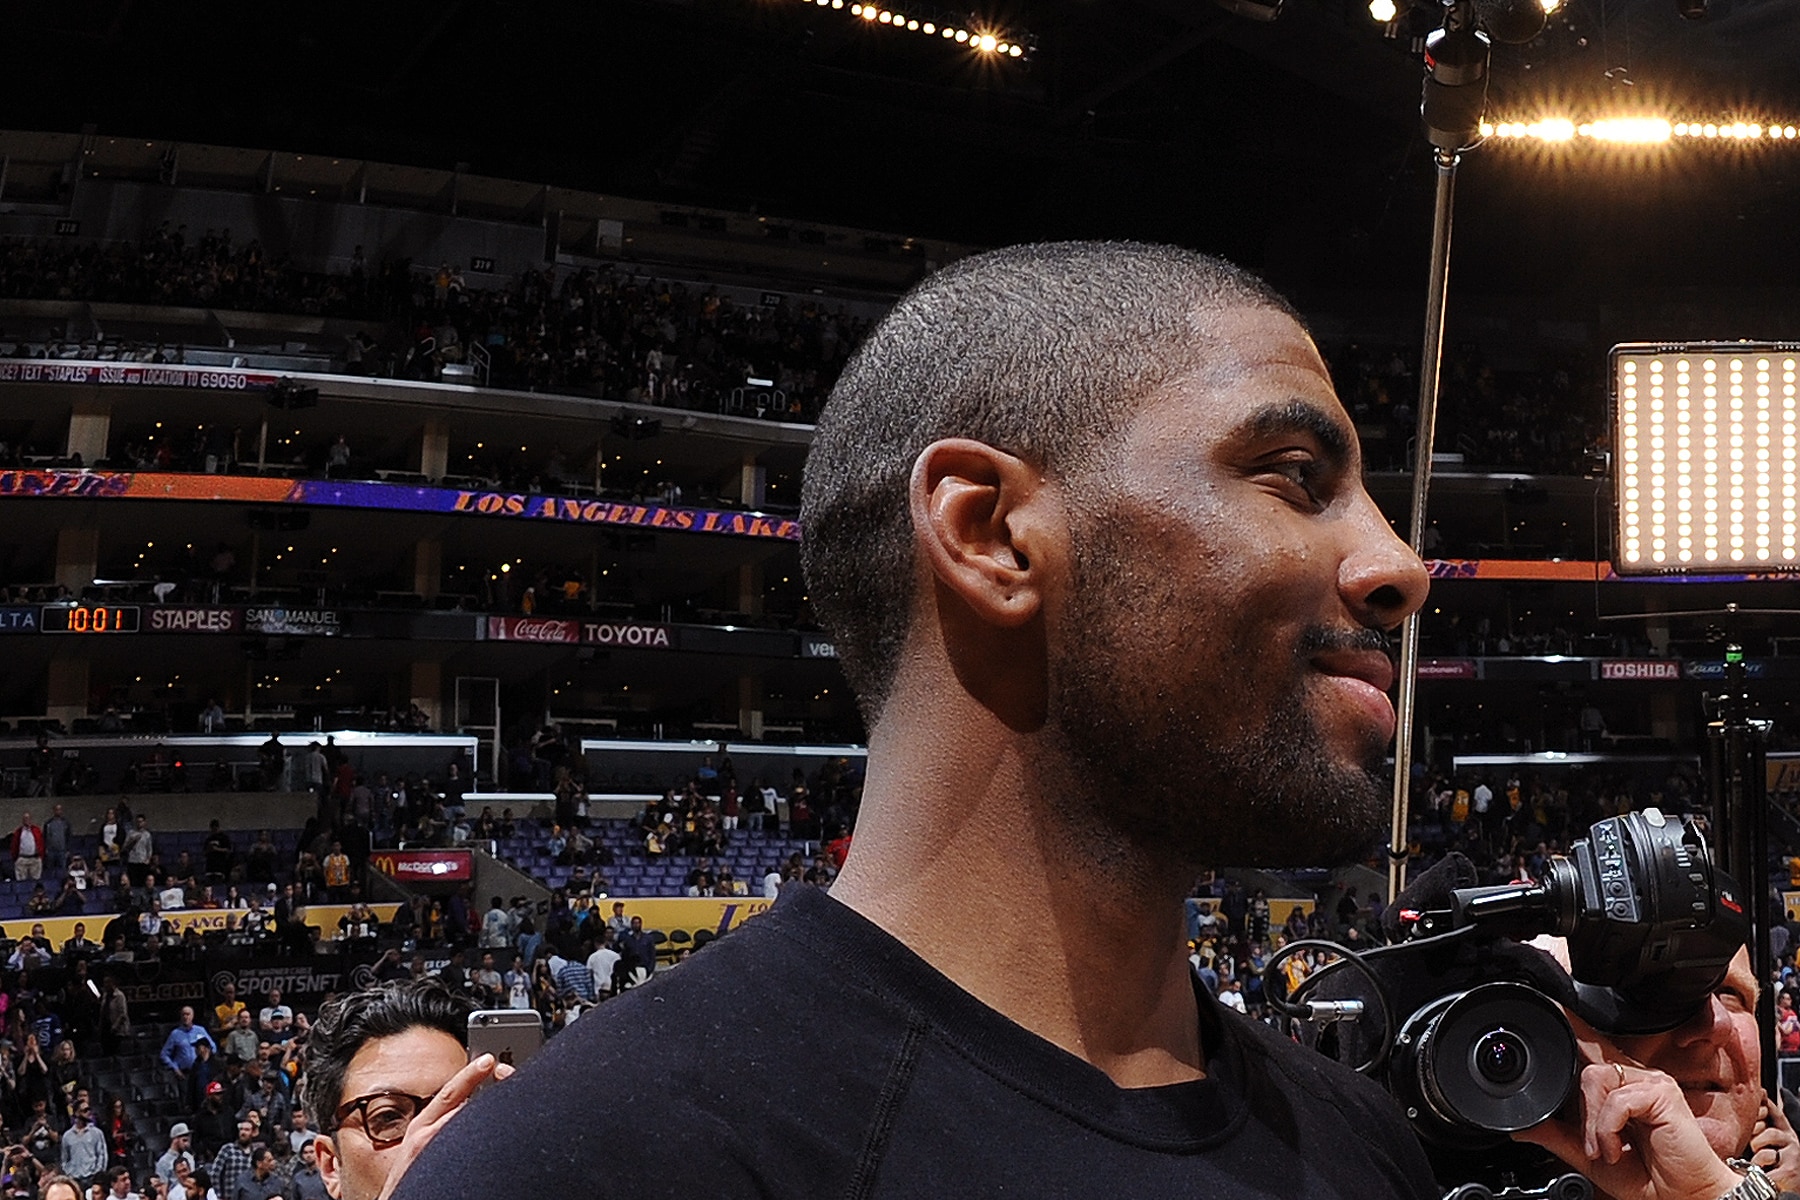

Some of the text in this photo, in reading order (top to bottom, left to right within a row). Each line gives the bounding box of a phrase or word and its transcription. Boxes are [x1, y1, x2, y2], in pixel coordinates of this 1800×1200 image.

[20, 365, 43, 381] TEXT
[99, 367, 126, 385] ISSUE
[142, 370, 186, 387] LOCATION
[187, 373, 199, 387] TO
[200, 373, 247, 390] 69050
[455, 491, 525, 515] LOS
[531, 498, 695, 530] ANGELES
[151, 609, 232, 631] STAPLES
[246, 609, 340, 625] SAN MANUEL
[585, 624, 669, 646] TOYOTA
[1602, 664, 1678, 680] TOSHIBA
